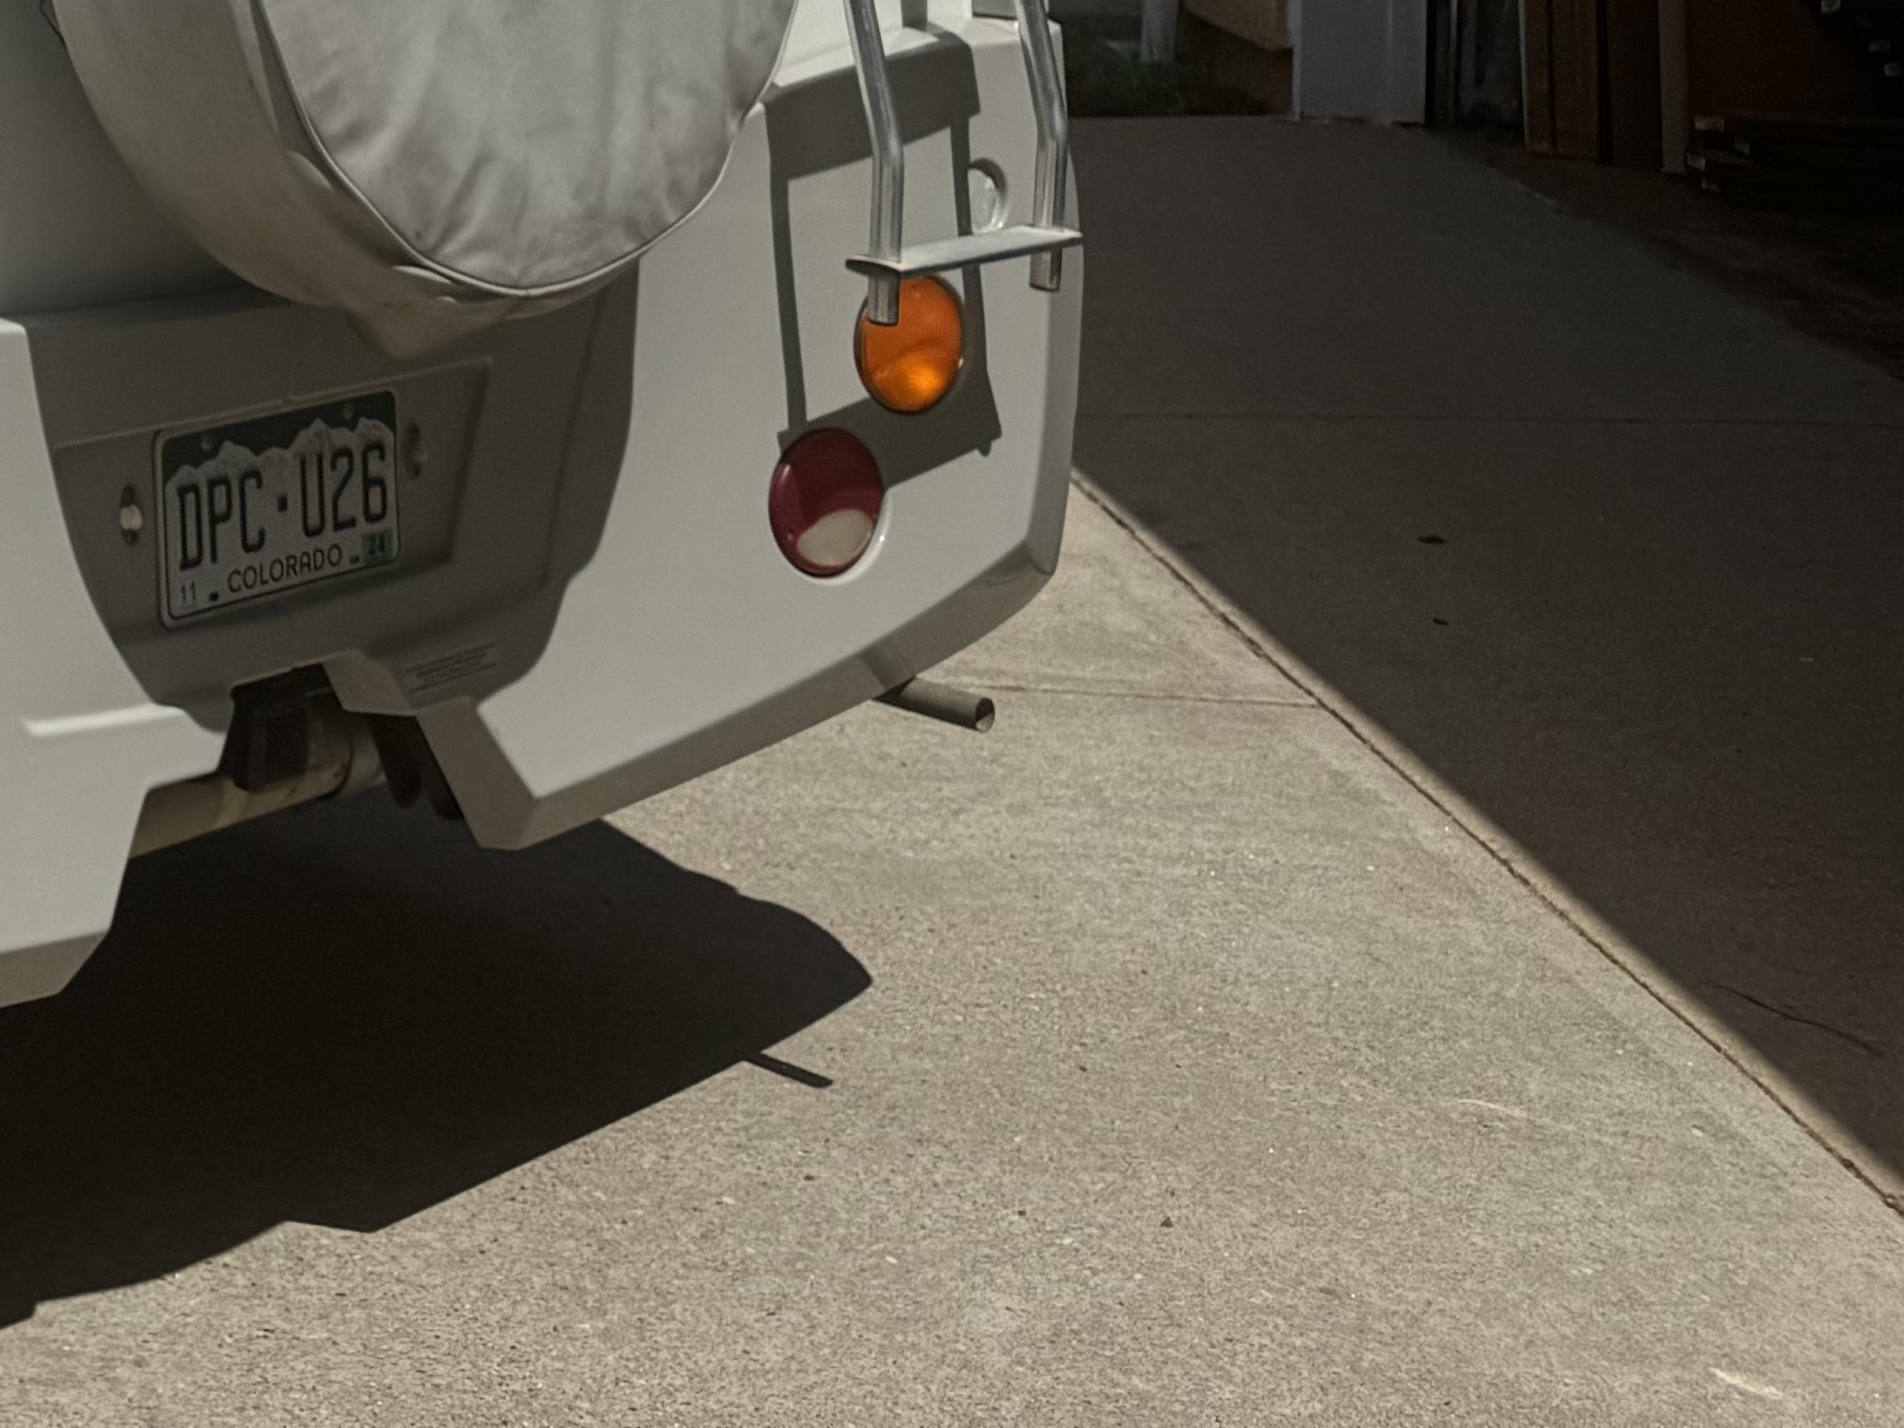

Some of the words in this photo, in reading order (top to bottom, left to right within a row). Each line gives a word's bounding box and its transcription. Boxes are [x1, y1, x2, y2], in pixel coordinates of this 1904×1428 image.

[367, 534, 386, 554] 24
[226, 543, 343, 594] COLORADO
[177, 583, 197, 605] 11
